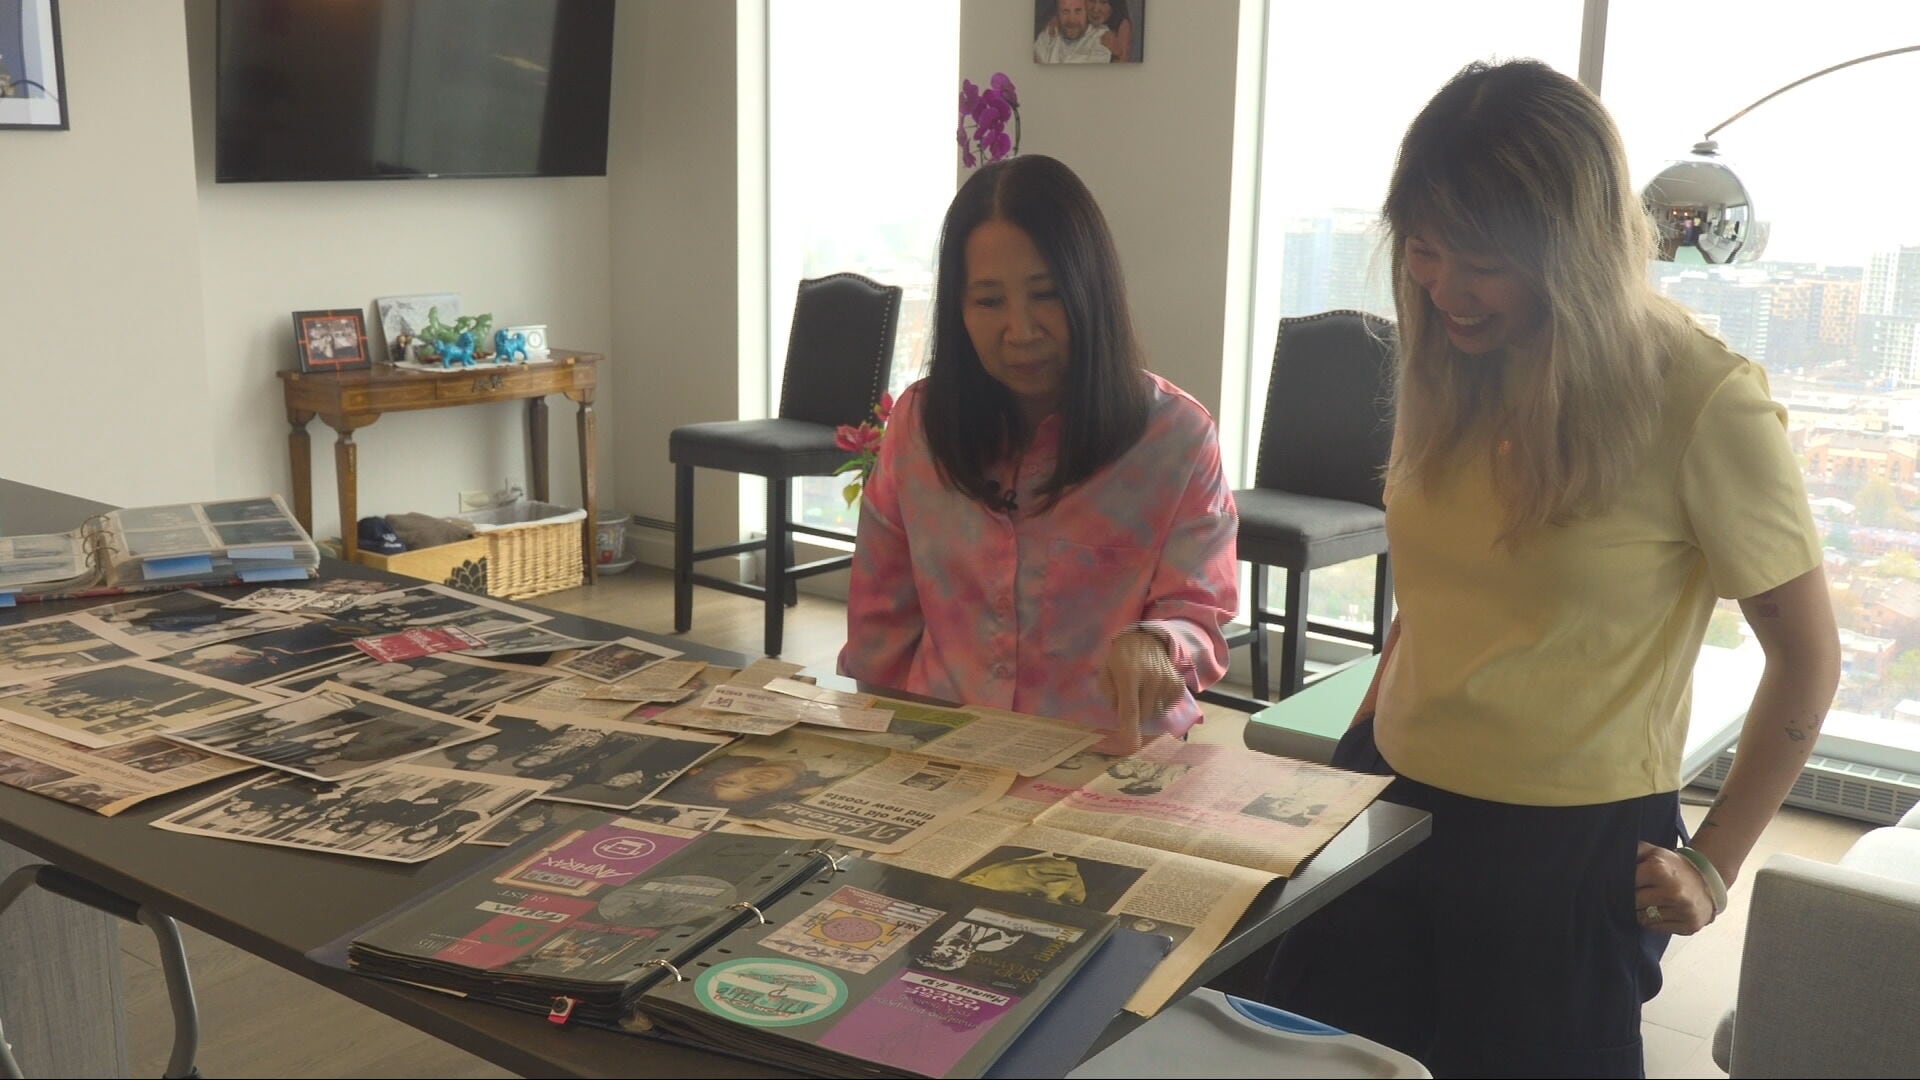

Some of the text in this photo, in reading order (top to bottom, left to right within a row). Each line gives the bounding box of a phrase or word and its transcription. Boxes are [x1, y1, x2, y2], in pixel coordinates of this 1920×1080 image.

[818, 799, 926, 827] How old Tories
[824, 792, 936, 821] find new roosts
[541, 856, 633, 879] ANTHRAX
[904, 986, 981, 1011] HOUSE
[915, 986, 979, 1005] CREW
